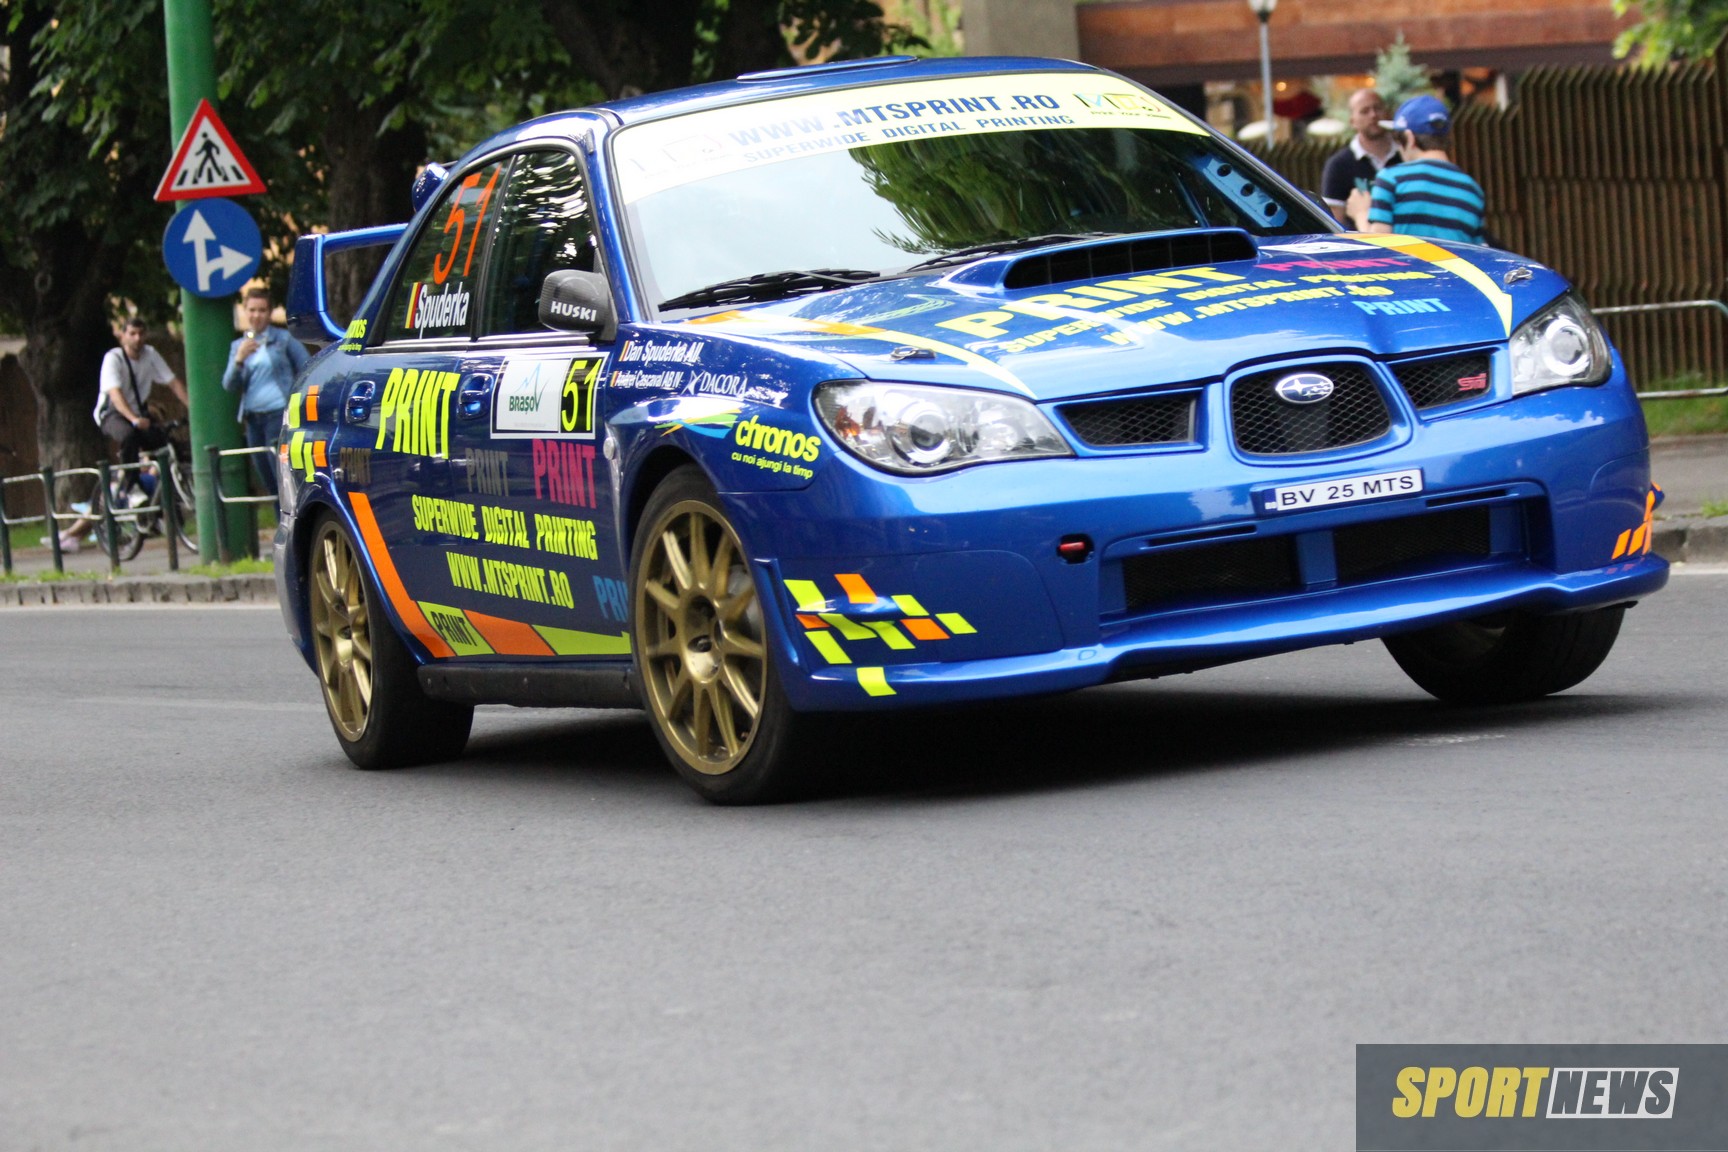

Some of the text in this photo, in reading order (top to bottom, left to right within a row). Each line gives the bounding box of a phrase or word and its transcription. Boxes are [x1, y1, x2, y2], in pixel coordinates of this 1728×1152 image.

[743, 114, 1075, 162] SUPERWIDE DIGITAL PRINTING
[433, 164, 502, 285] 51
[415, 282, 470, 339] Spuderka
[550, 301, 597, 322] HUSKI
[935, 267, 1246, 339] PRINT
[1003, 298, 1173, 353] SUPERWIDE
[1176, 279, 1297, 301] DIGITAL
[1352, 298, 1451, 316] PRINT
[624, 340, 644, 361] Dan
[641, 340, 687, 366] Spuderka
[560, 358, 602, 432] 51
[700, 371, 748, 396] DACORA
[375, 367, 461, 460] PRINT
[735, 415, 822, 462] chronos
[465, 447, 509, 496] PRINT
[532, 438, 597, 509] PRINT
[731, 452, 742, 461] cu
[742, 454, 756, 464] noi
[756, 457, 782, 472] ajungi
[793, 465, 813, 479] timp
[1281, 488, 1315, 507] BV
[1327, 484, 1355, 500] 25
[1363, 475, 1414, 496] MTS
[412, 494, 599, 561] SUPERWIDE DIGITAL PRINTING
[446, 551, 574, 609] WWW.MTSPRINT.RO
[431, 611, 478, 647] PRINT
